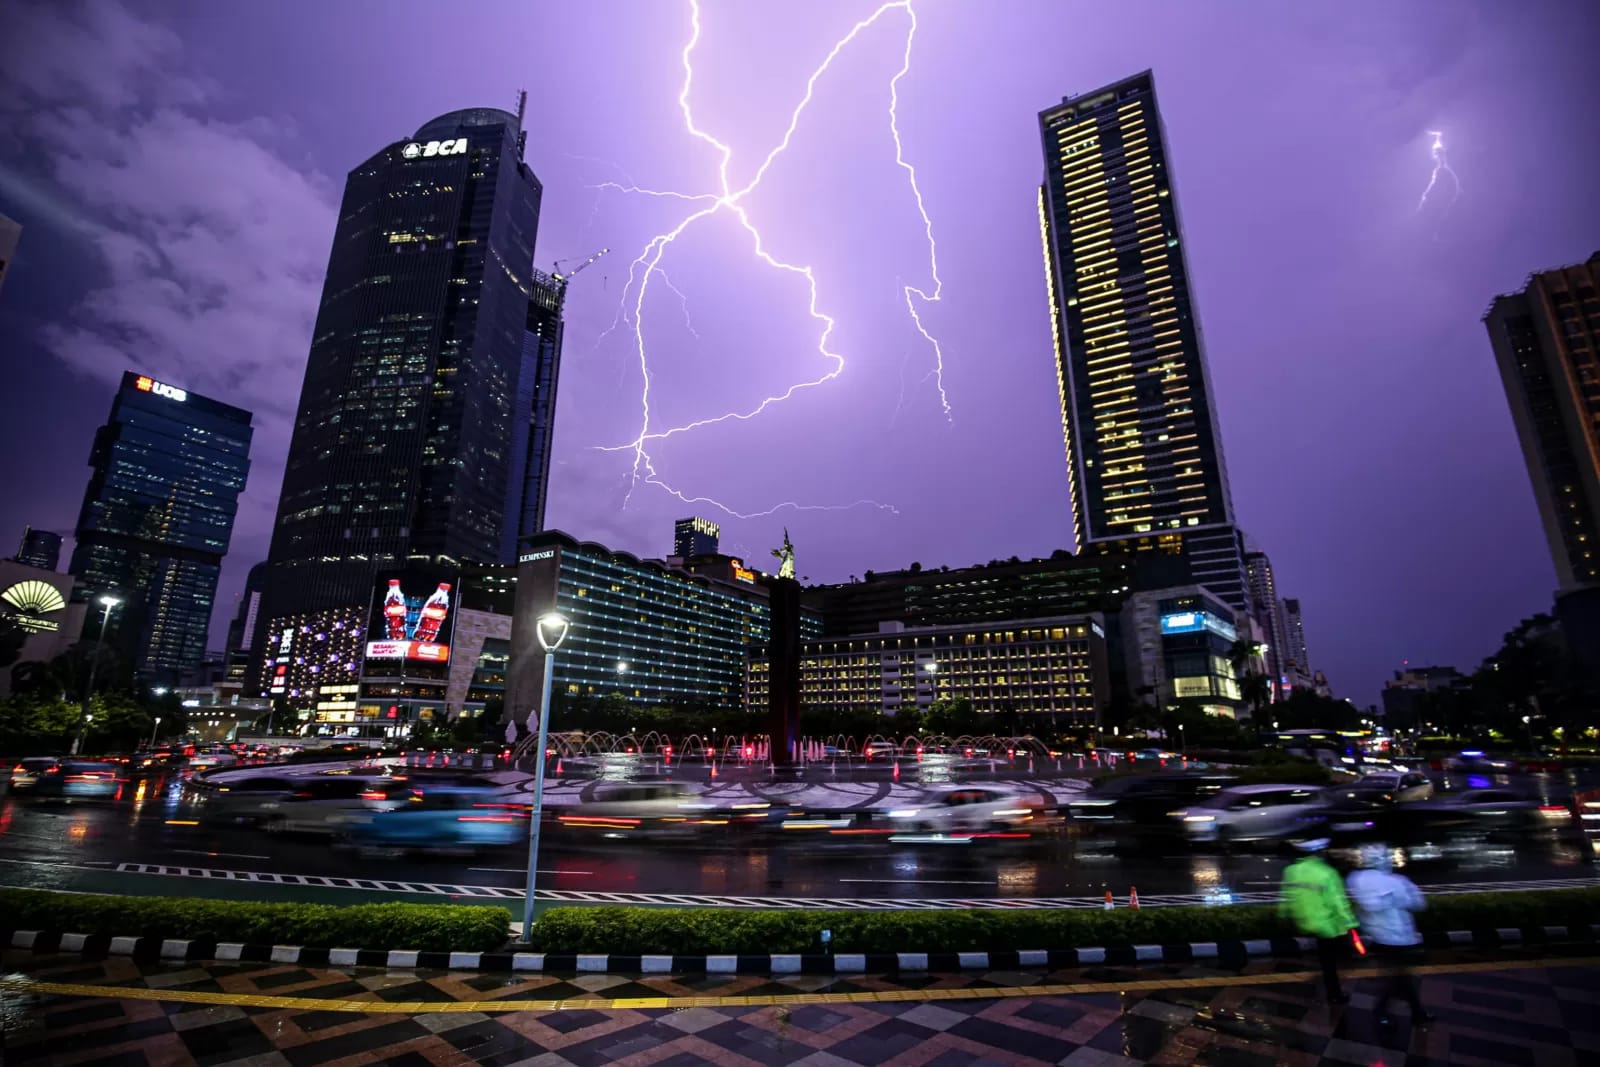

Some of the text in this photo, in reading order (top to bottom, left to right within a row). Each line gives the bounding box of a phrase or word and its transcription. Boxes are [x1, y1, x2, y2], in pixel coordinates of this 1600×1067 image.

[423, 138, 468, 157] BCA
[152, 381, 187, 402] UOB
[519, 550, 554, 563] KEMPINSKI
